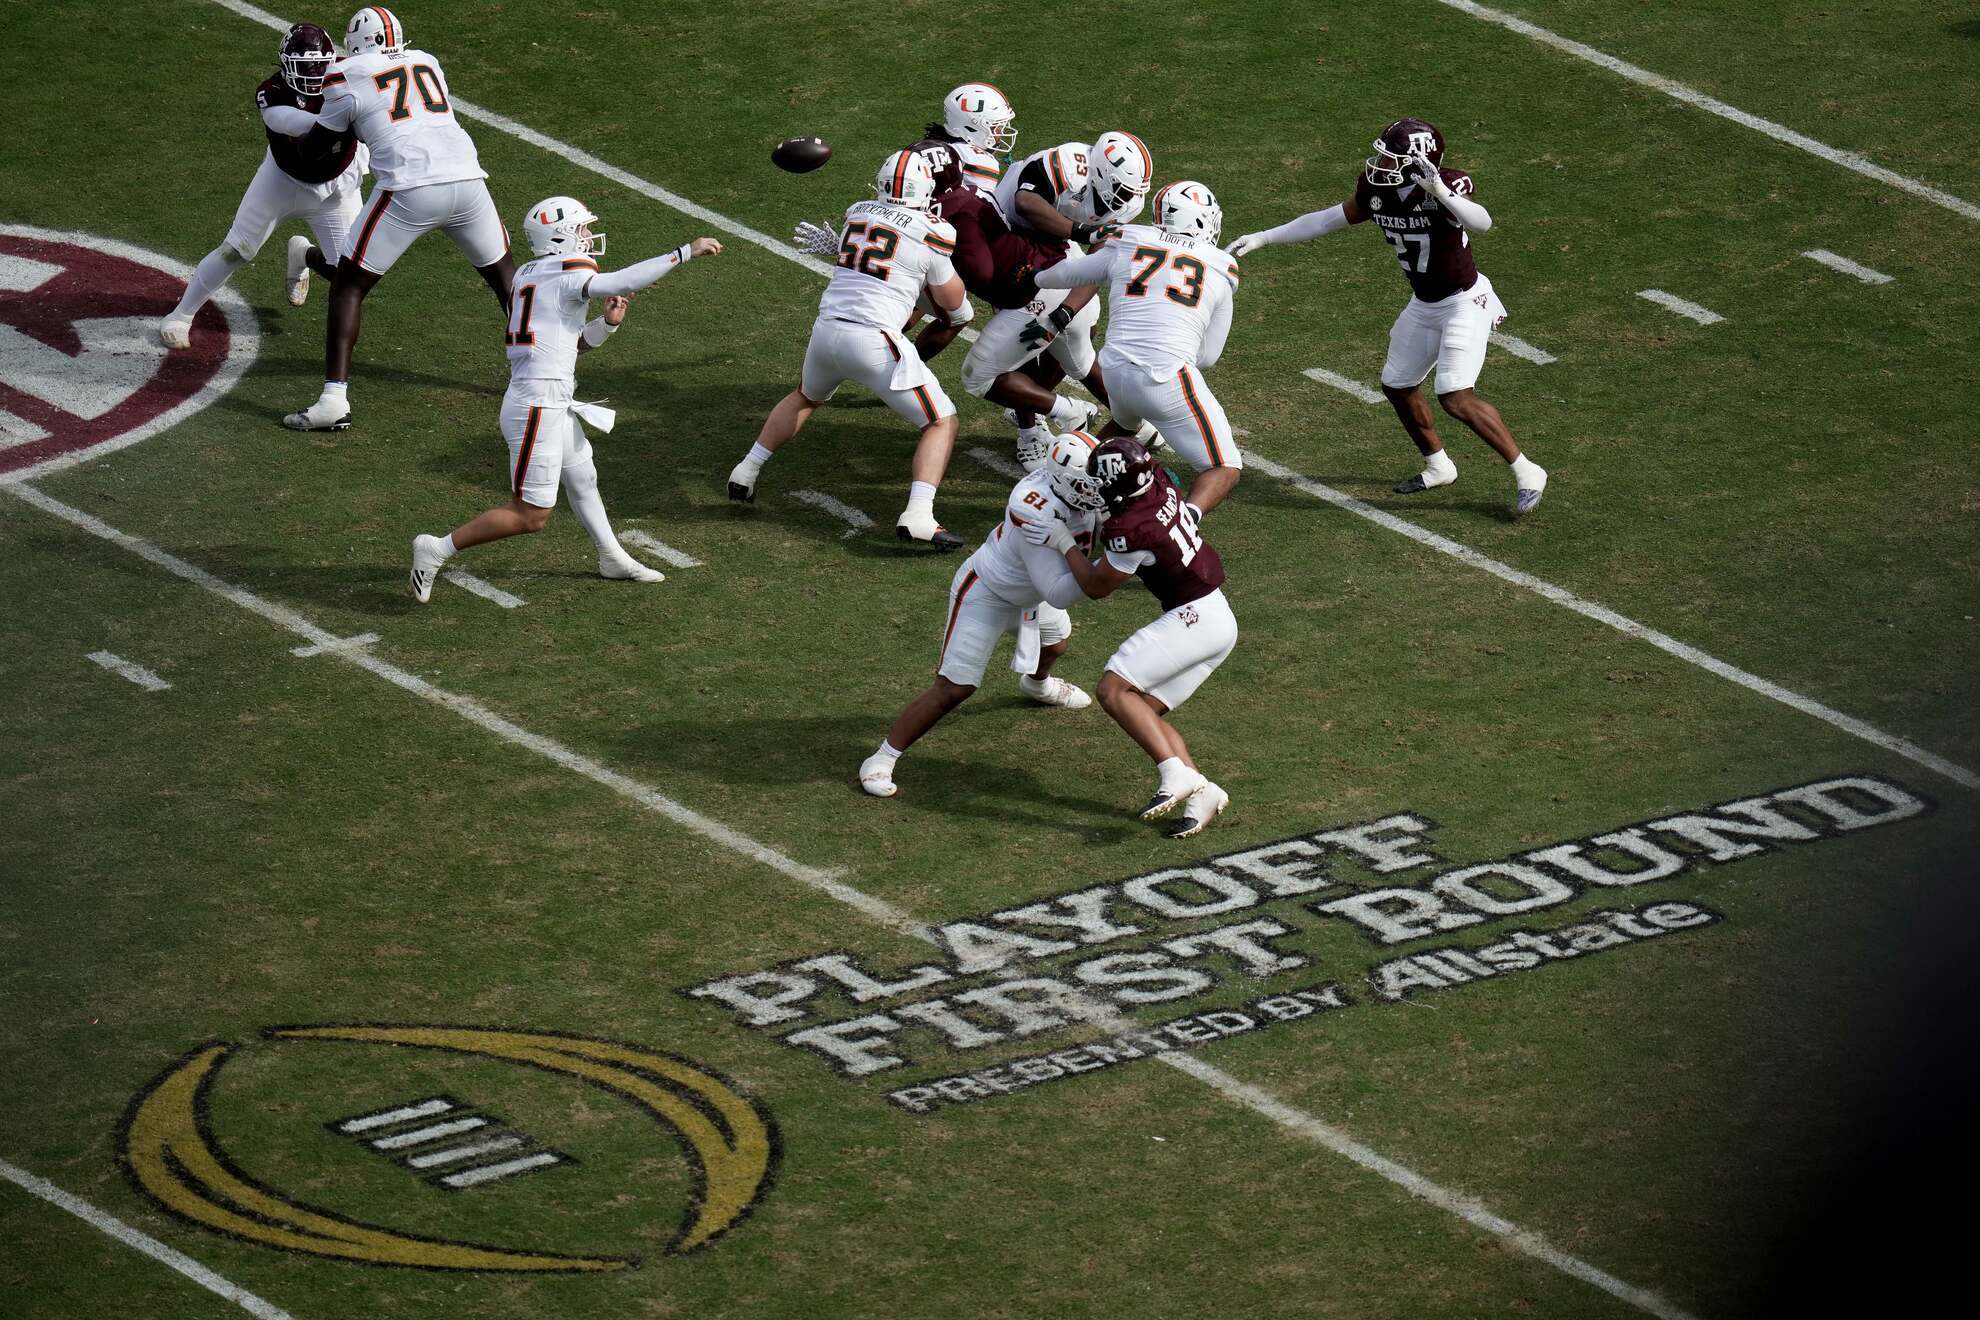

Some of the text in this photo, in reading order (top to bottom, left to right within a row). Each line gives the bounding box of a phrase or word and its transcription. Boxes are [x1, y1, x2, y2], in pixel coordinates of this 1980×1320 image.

[256, 90, 269, 109] 5
[373, 64, 448, 123] 70
[960, 98, 985, 113] U
[1073, 152, 1088, 177] 63
[1103, 145, 1126, 168] U
[1451, 175, 1474, 195] 27
[886, 198, 907, 206] MIAMI
[539, 207, 565, 225] U
[1373, 213, 1431, 229] TEXAS A&M
[836, 221, 901, 282] 52
[1385, 229, 1431, 273] 27
[1124, 245, 1208, 310] 73
[1051, 446, 1072, 467] U
[1022, 490, 1049, 512] 61
[1108, 535, 1128, 552] 18
[688, 812, 1434, 1027] PLAYOFF
[784, 776, 1926, 1077] FIRST ROUND
[889, 902, 1715, 1112] PRESENTED BY Allstate
